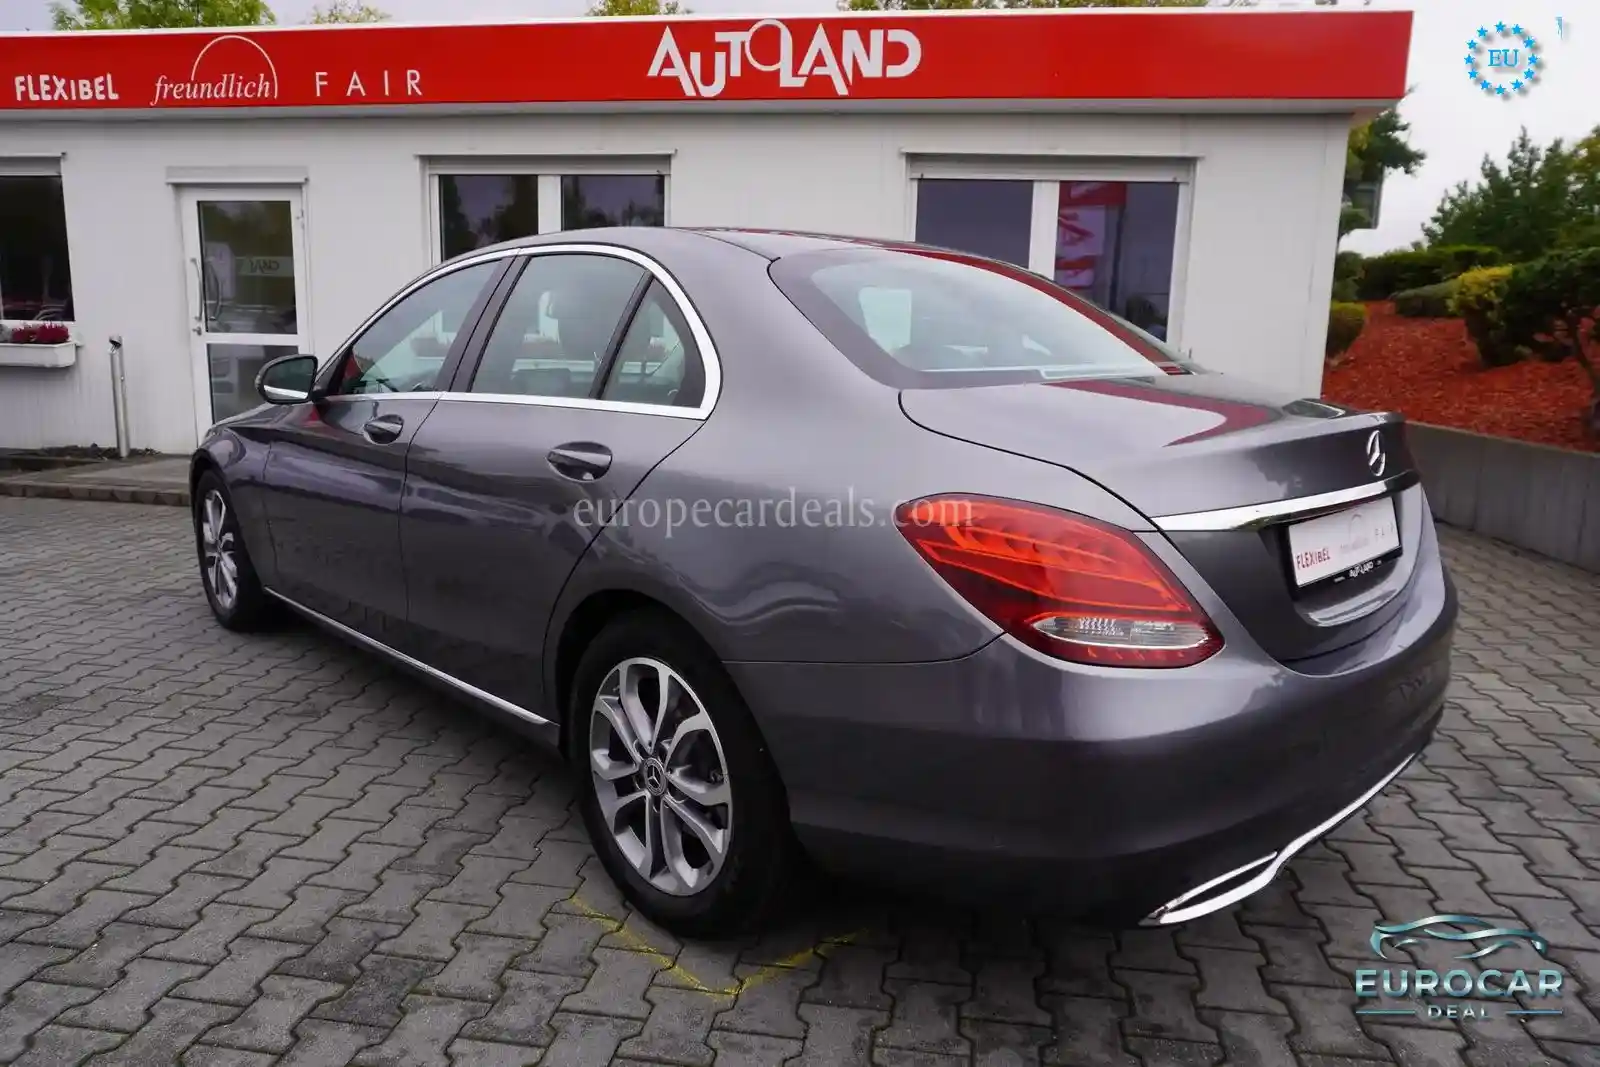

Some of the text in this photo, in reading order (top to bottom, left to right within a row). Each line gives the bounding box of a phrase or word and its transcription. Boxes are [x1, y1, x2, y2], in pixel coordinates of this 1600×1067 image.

[15, 73, 119, 102] FLEXIBEL
[150, 74, 271, 106] freundlich
[1296, 547, 1331, 570] FLEXIBEL
